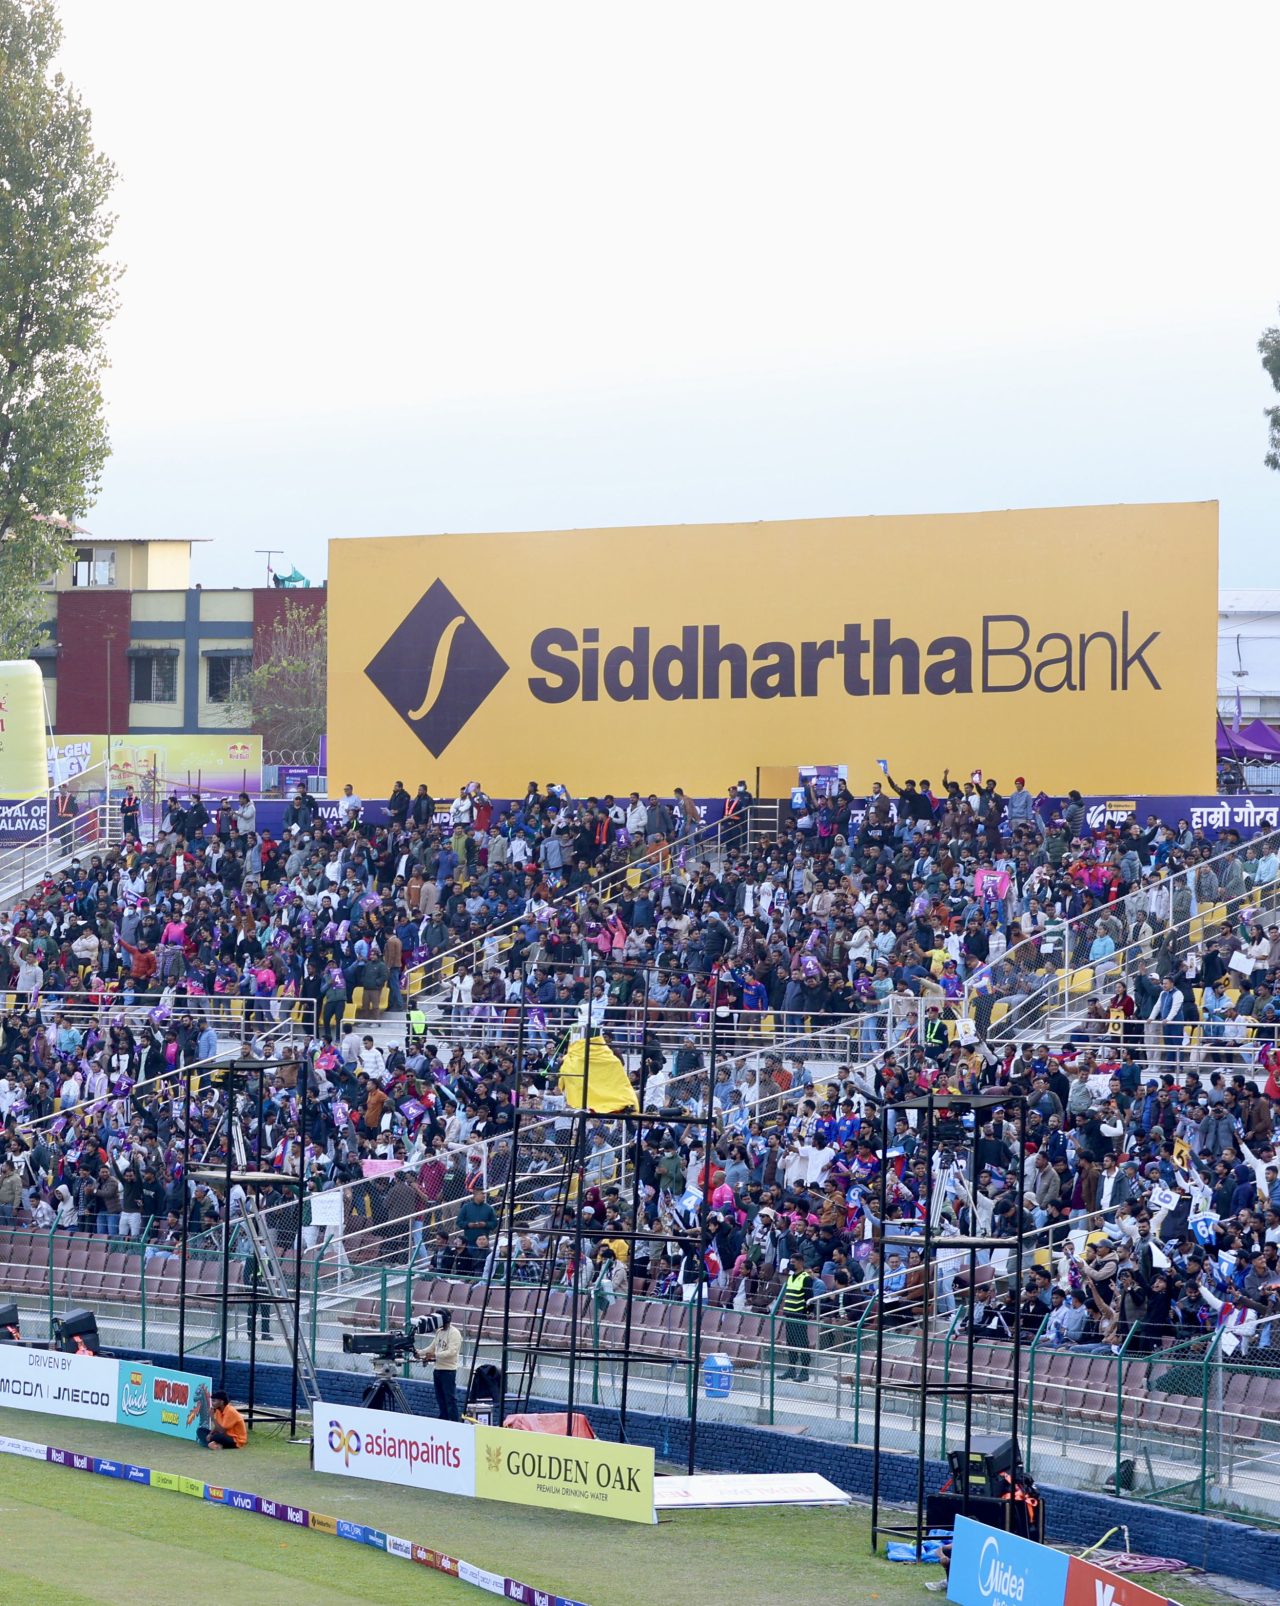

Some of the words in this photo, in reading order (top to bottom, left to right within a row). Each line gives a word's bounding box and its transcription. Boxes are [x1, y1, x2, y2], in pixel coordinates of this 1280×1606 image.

[793, 793, 802, 804] 4
[31, 805, 47, 818] OF
[1190, 801, 1231, 829] हाम्रो
[1233, 799, 1279, 827] गौरव
[619, 835, 625, 843] 4
[279, 894, 287, 903] 4
[987, 887, 994, 897] 4
[303, 921, 309, 930] 4
[324, 929, 330, 937] 4
[806, 961, 813, 970] 4
[335, 975, 340, 983] 4
[533, 1015, 540, 1025] 4
[337, 1110, 343, 1118] 4
[409, 1106, 417, 1114] 4
[686, 1198, 696, 1210] 4
[28, 1354, 59, 1369] DRIVEN
[61, 1359, 72, 1371] BY
[53, 1386, 109, 1407] JAECOO
[122, 1384, 148, 1416] Quick
[51, 1449, 65, 1463] Ncell
[364, 1428, 461, 1474] asianpaints
[73, 1455, 87, 1469] Ncell
[507, 1451, 589, 1485] GOLDEN
[597, 1462, 641, 1493] OAK
[536, 1483, 560, 1496] PREMIUM
[562, 1487, 588, 1499] DRINKING
[589, 1491, 608, 1502] WATER
[233, 1494, 251, 1509] vivo
[261, 1500, 275, 1516] Ncell
[287, 1507, 303, 1523] Ncell
[981, 1550, 1025, 1600] Midea
[510, 1581, 524, 1599] Ncell
